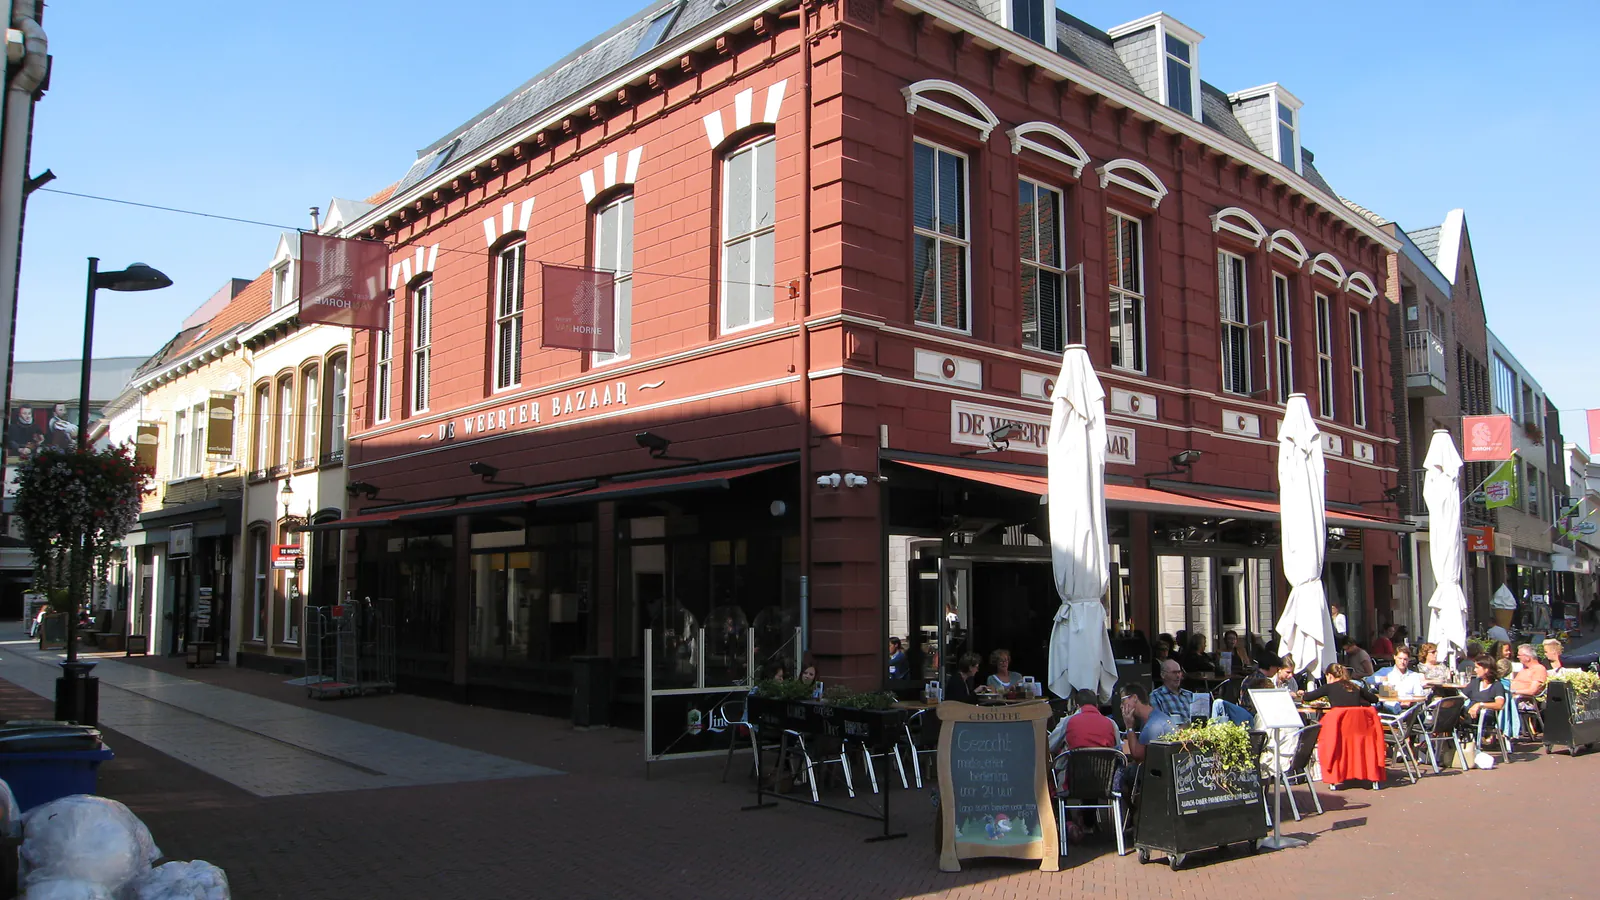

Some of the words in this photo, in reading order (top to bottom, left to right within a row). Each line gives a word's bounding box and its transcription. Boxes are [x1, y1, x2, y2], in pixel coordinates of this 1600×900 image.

[573, 325, 602, 335] HORNE
[438, 421, 455, 441] DE
[464, 401, 541, 434] WEERTER
[552, 381, 628, 417] BAZAAR
[958, 411, 985, 436] DE
[968, 712, 1021, 721] CHOUFFE
